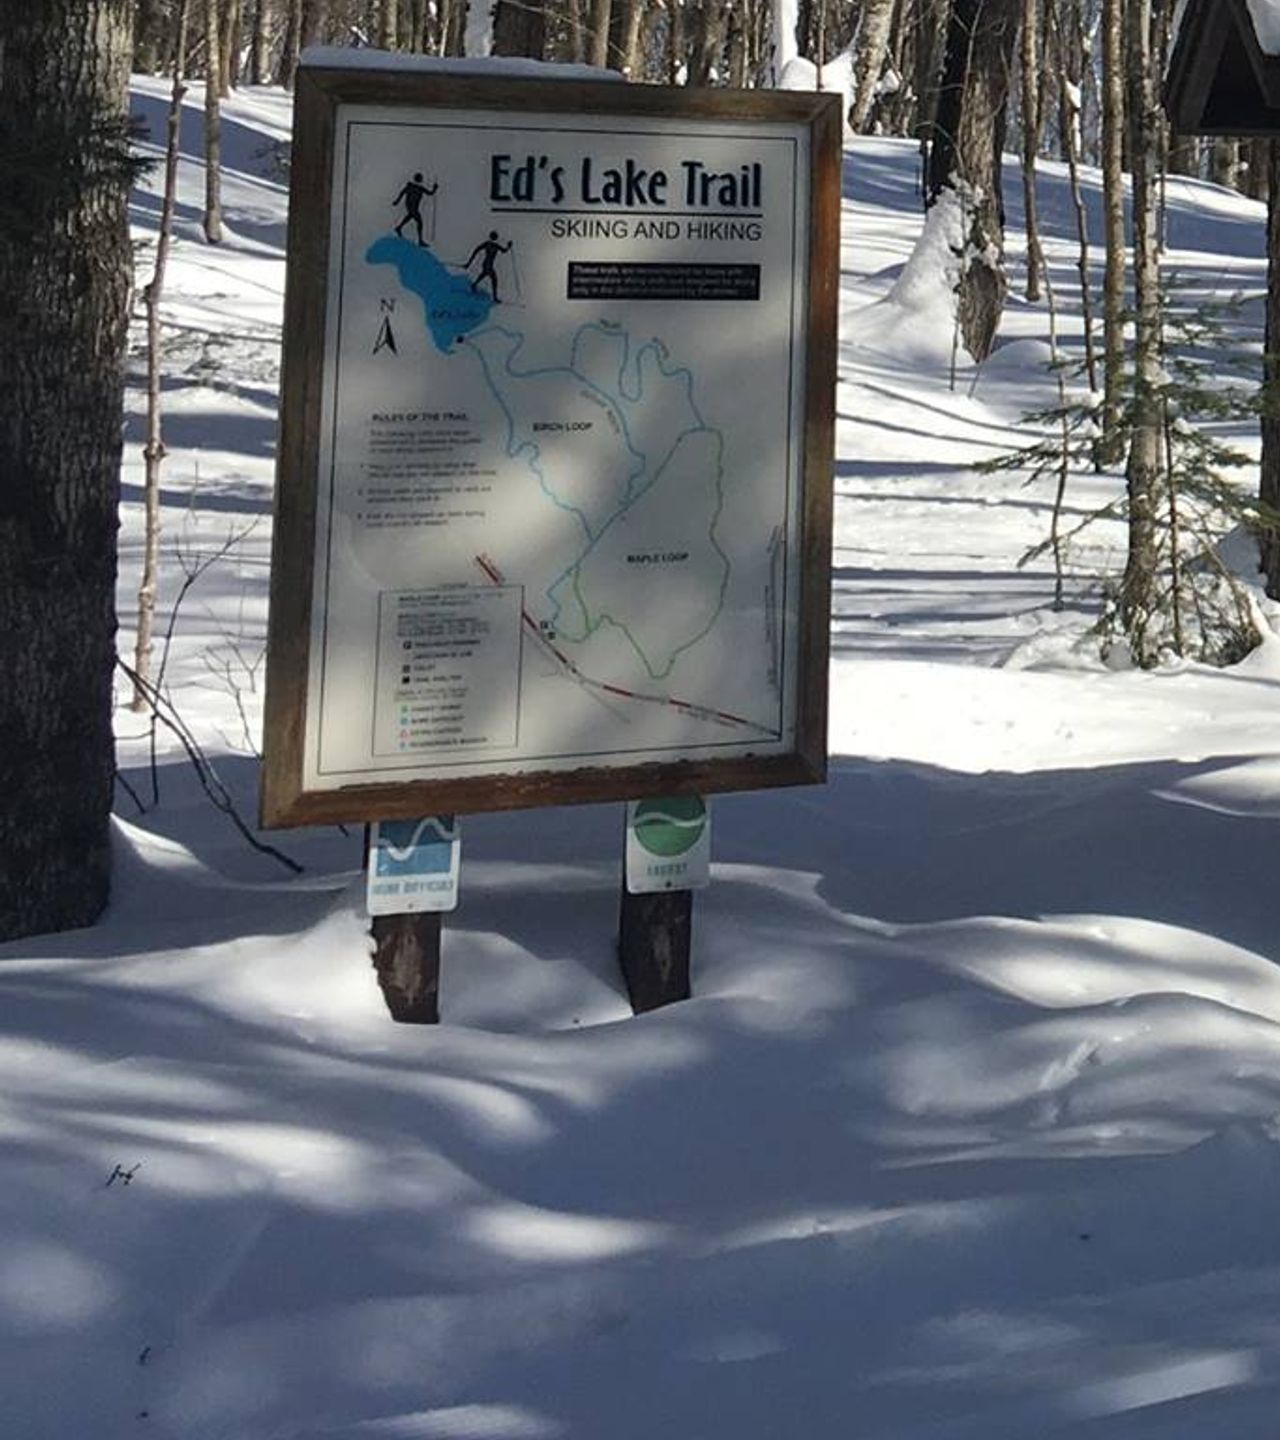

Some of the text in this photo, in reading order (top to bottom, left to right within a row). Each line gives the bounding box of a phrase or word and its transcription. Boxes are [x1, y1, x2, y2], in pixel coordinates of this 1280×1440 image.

[490, 155, 761, 207] Ed's Lake Trail
[551, 219, 762, 241] SKIING AND HIKING
[380, 299, 396, 311] N
[533, 422, 593, 432] BIRCH LOOP
[662, 552, 689, 562] LOOP
